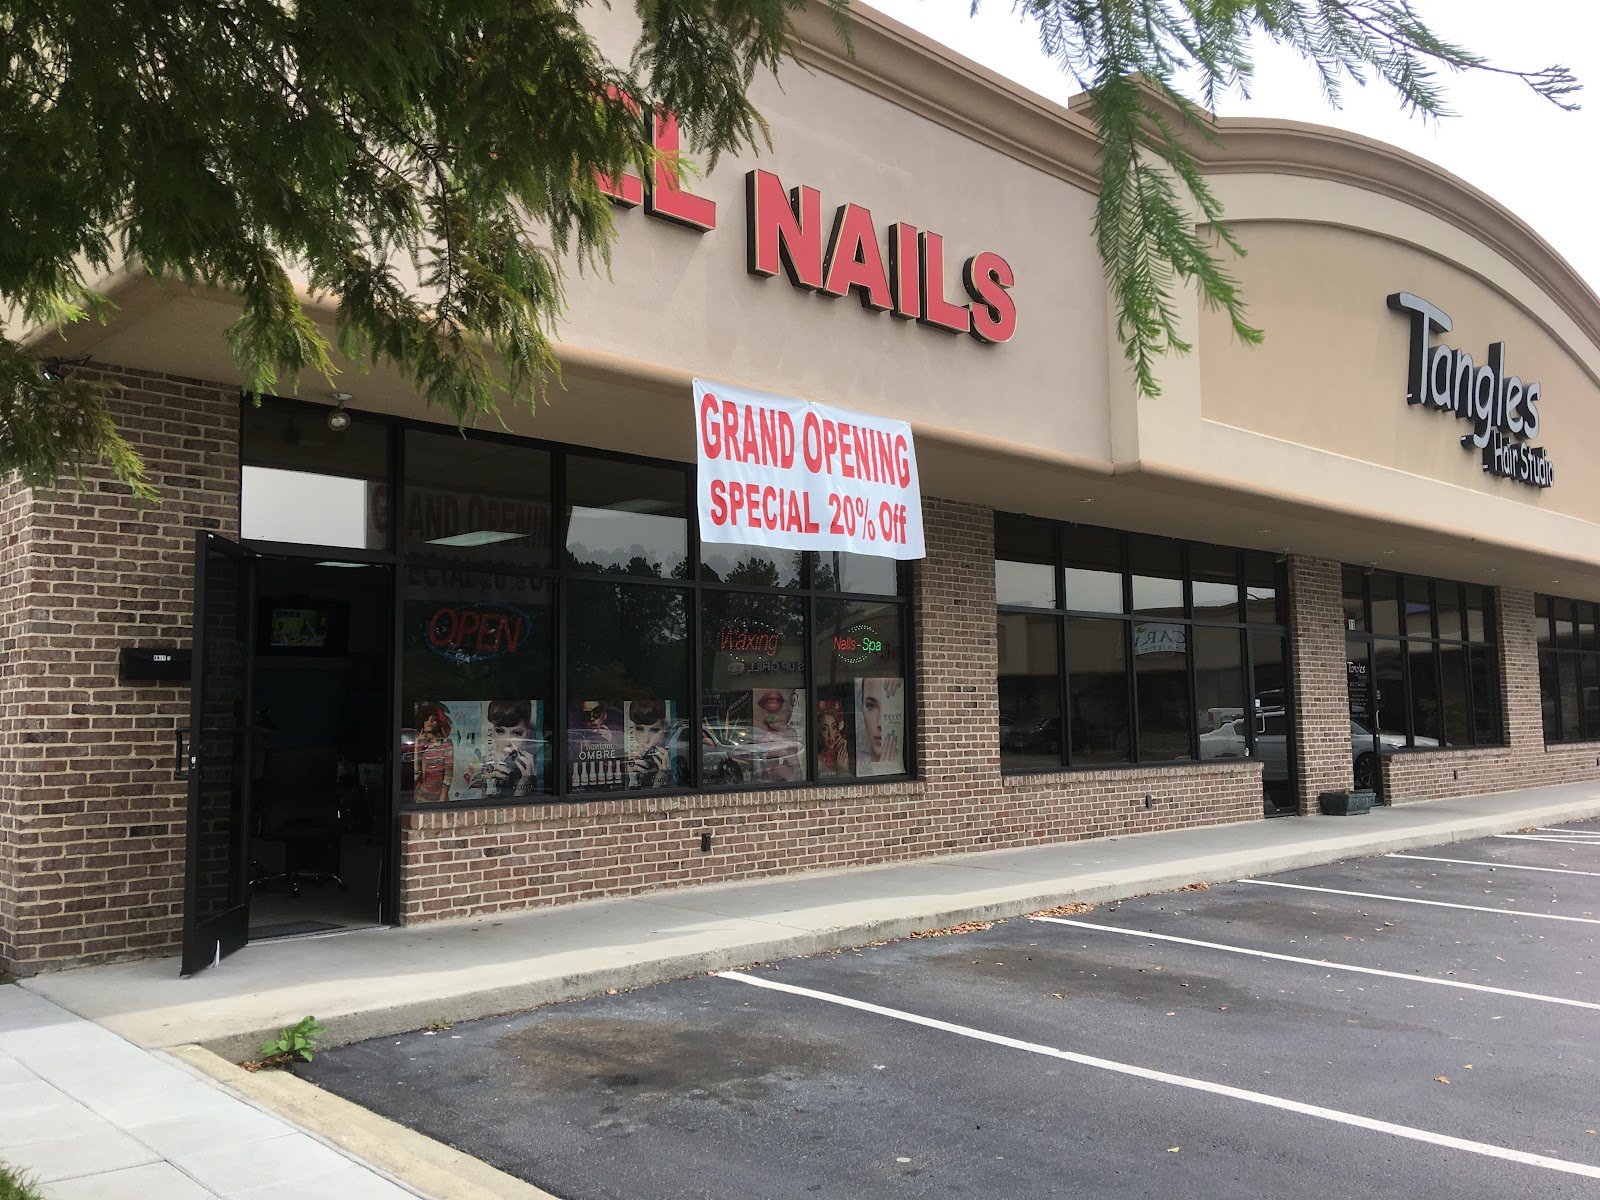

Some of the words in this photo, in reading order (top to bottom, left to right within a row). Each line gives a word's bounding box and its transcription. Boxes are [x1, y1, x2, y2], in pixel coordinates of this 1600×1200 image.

[747, 169, 1017, 343] NAILS
[1388, 292, 1541, 449] Tangles
[701, 393, 795, 470] GRAND
[803, 411, 911, 489] OPENING
[1490, 431, 1518, 477] Hair
[1519, 442, 1554, 488] Studio
[710, 479, 820, 534] SPECIAL
[829, 493, 876, 541] 20%
[878, 501, 906, 545] Off
[428, 608, 522, 652] OPEN
[721, 625, 780, 656] Waxing
[578, 749, 616, 760] OMBRE
[580, 742, 614, 752] Phantom
